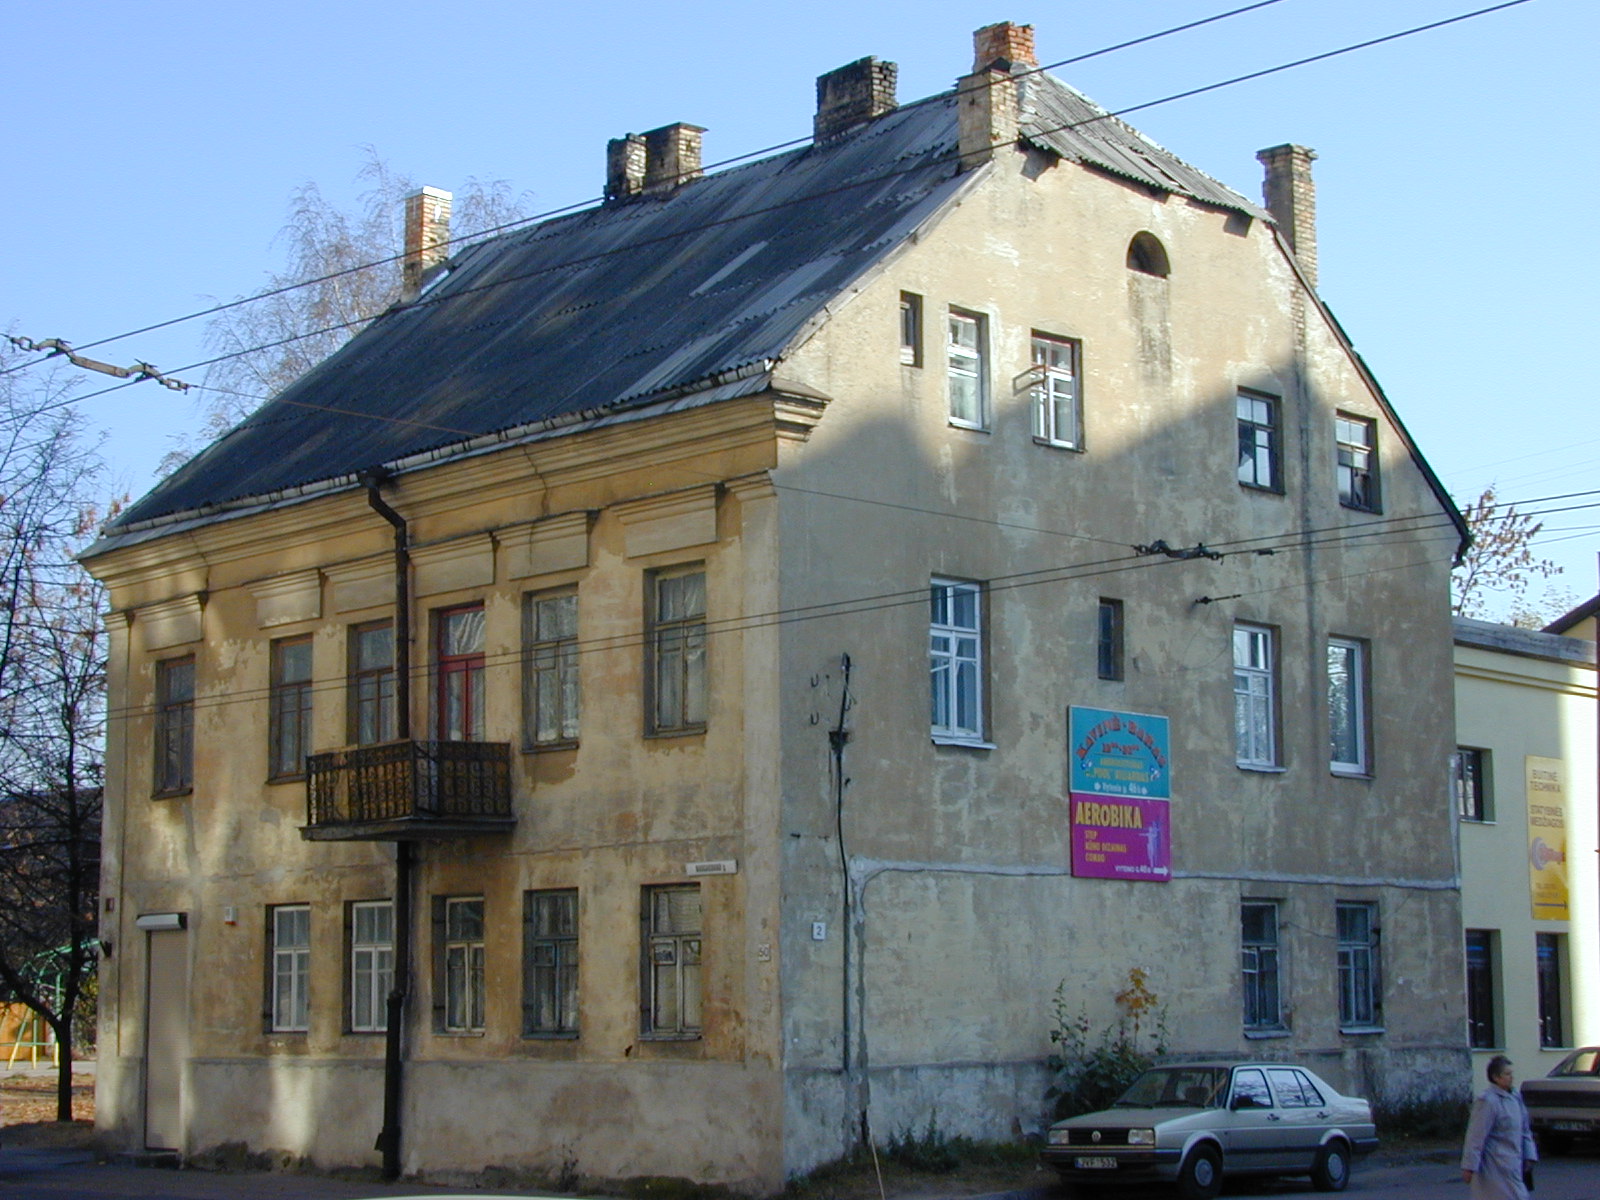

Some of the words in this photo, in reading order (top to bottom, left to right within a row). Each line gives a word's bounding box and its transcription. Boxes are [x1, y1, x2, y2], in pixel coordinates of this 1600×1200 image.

[1530, 780, 1560, 792] TECHNIKA
[1075, 801, 1143, 829] AEROBIKA
[816, 926, 822, 936] 2
